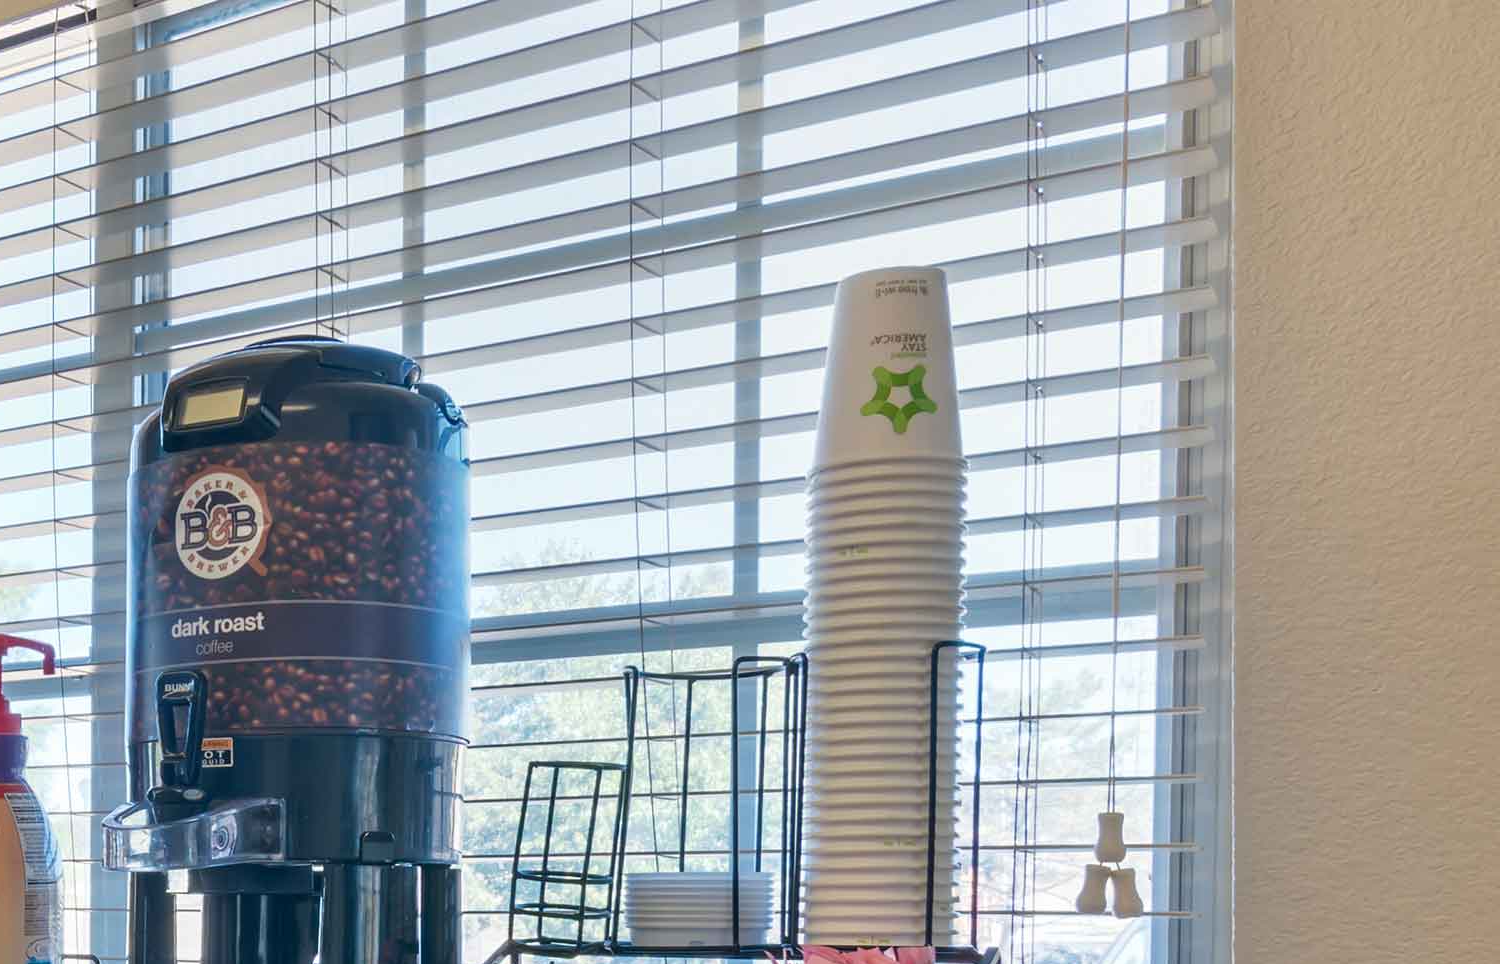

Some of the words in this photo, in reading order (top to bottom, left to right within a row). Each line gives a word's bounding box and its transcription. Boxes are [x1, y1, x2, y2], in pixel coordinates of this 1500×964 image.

[874, 333, 927, 345] AMERICA
[901, 343, 927, 352] STAY
[180, 504, 258, 550] B&B
[171, 617, 210, 638] dark
[214, 611, 265, 634] roast
[195, 640, 234, 656] coffee
[203, 749, 225, 759] OT
